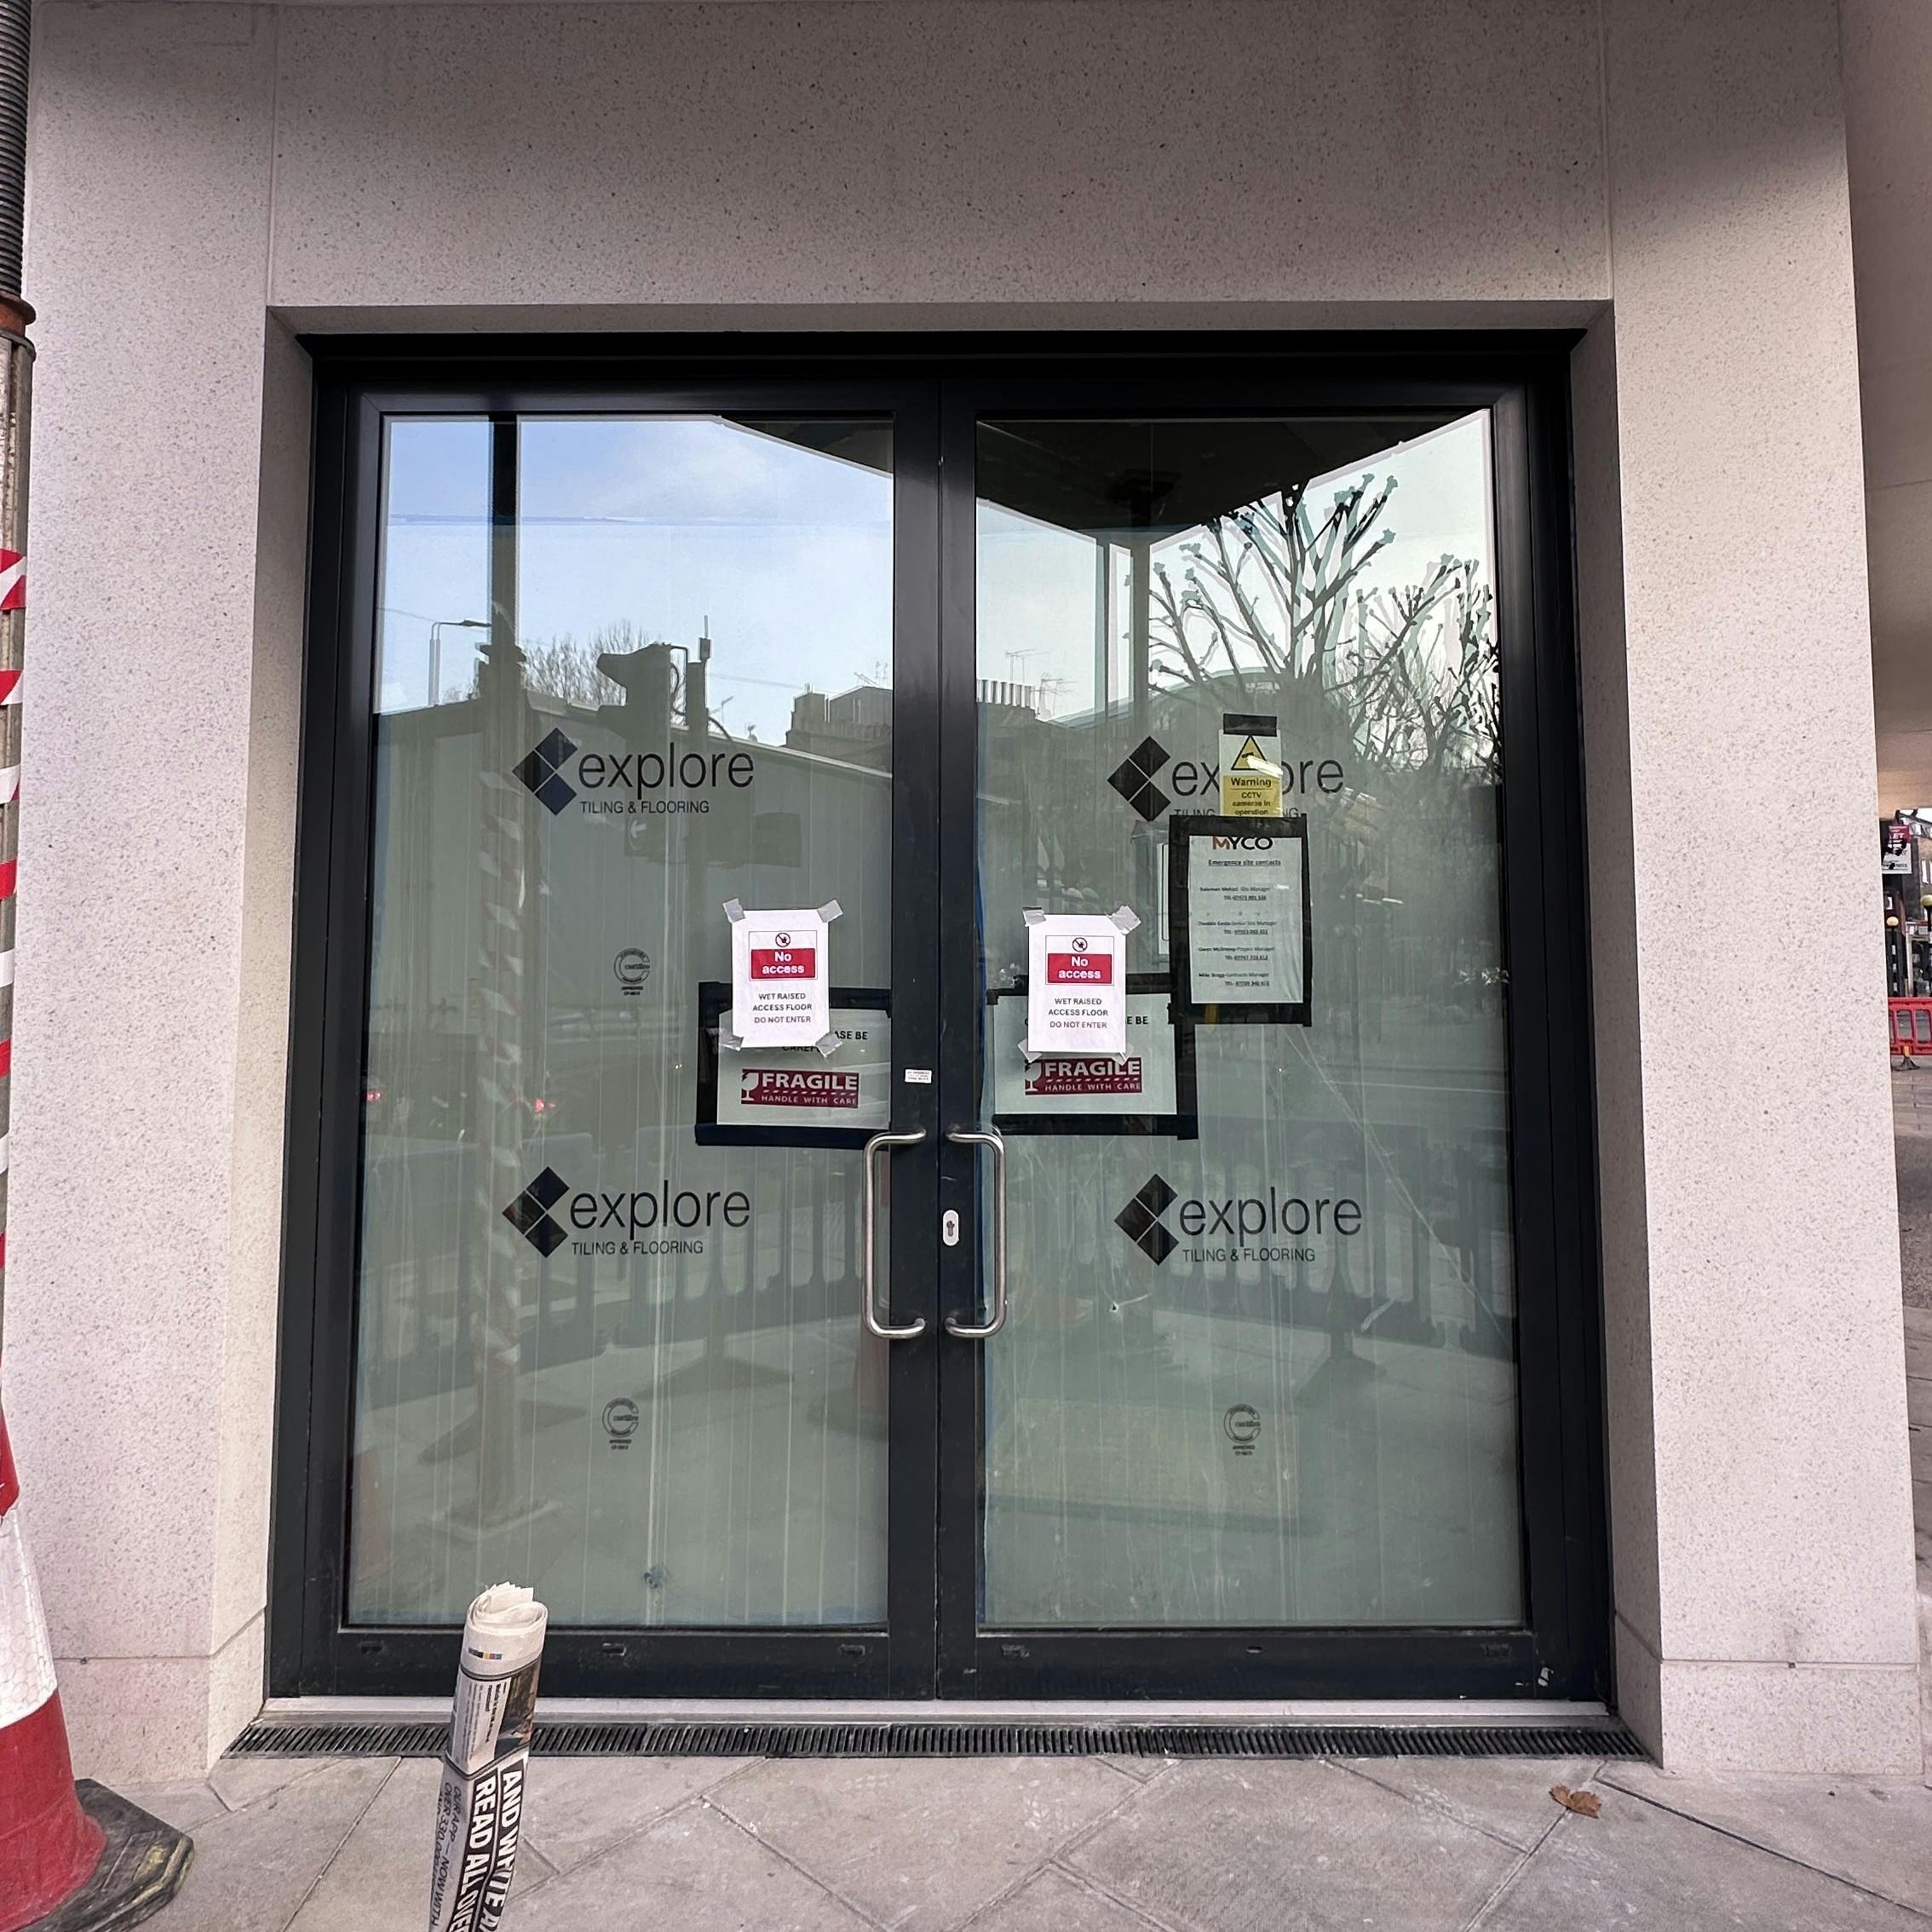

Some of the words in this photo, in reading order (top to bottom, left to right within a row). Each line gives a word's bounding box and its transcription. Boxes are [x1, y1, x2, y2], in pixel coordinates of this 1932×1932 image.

[578, 742, 755, 800] explore
[1171, 759, 1343, 796] exore
[1230, 776, 1272, 788] Warning
[580, 801, 624, 814] TILING
[627, 801, 637, 814] &
[641, 801, 710, 814] FLOORING
[1212, 836, 1273, 850] MYCO
[774, 952, 792, 962] No
[1071, 957, 1089, 967] No
[762, 964, 805, 975] access
[1058, 969, 1101, 979] access
[1135, 1016, 1149, 1025] BE
[854, 1031, 868, 1040] BE
[1044, 1061, 1141, 1077] FRAGILE
[761, 1072, 858, 1091] FRAGILE
[1044, 1083, 1083, 1091] HANDLE
[1087, 1083, 1112, 1091] WITH
[1117, 1082, 1141, 1090] CARE
[761, 1095, 798, 1104] HANDLE
[803, 1096, 828, 1105] WITH
[833, 1097, 858, 1106] CARE
[570, 1179, 750, 1240] explore
[1180, 1187, 1362, 1247] explore
[572, 1241, 616, 1256] TILING
[619, 1241, 630, 1255] &
[633, 1241, 704, 1255] FLOORING
[1182, 1248, 1227, 1262] TILING
[1229, 1248, 1239, 1262] &
[1243, 1248, 1316, 1262] FLOORING
[442, 1782, 452, 1816] OVER
[453, 1785, 462, 1814] OUR
[499, 1770, 523, 1828] AND
[469, 1776, 496, 1849] READ
[449, 1813, 460, 1842] APP
[436, 1856, 450, 1889] NOW
[460, 1854, 491, 1896] ALL
[485, 1827, 518, 1907] WHITE
[431, 1892, 444, 1926] WITH
[449, 1890, 478, 1932] OVE
